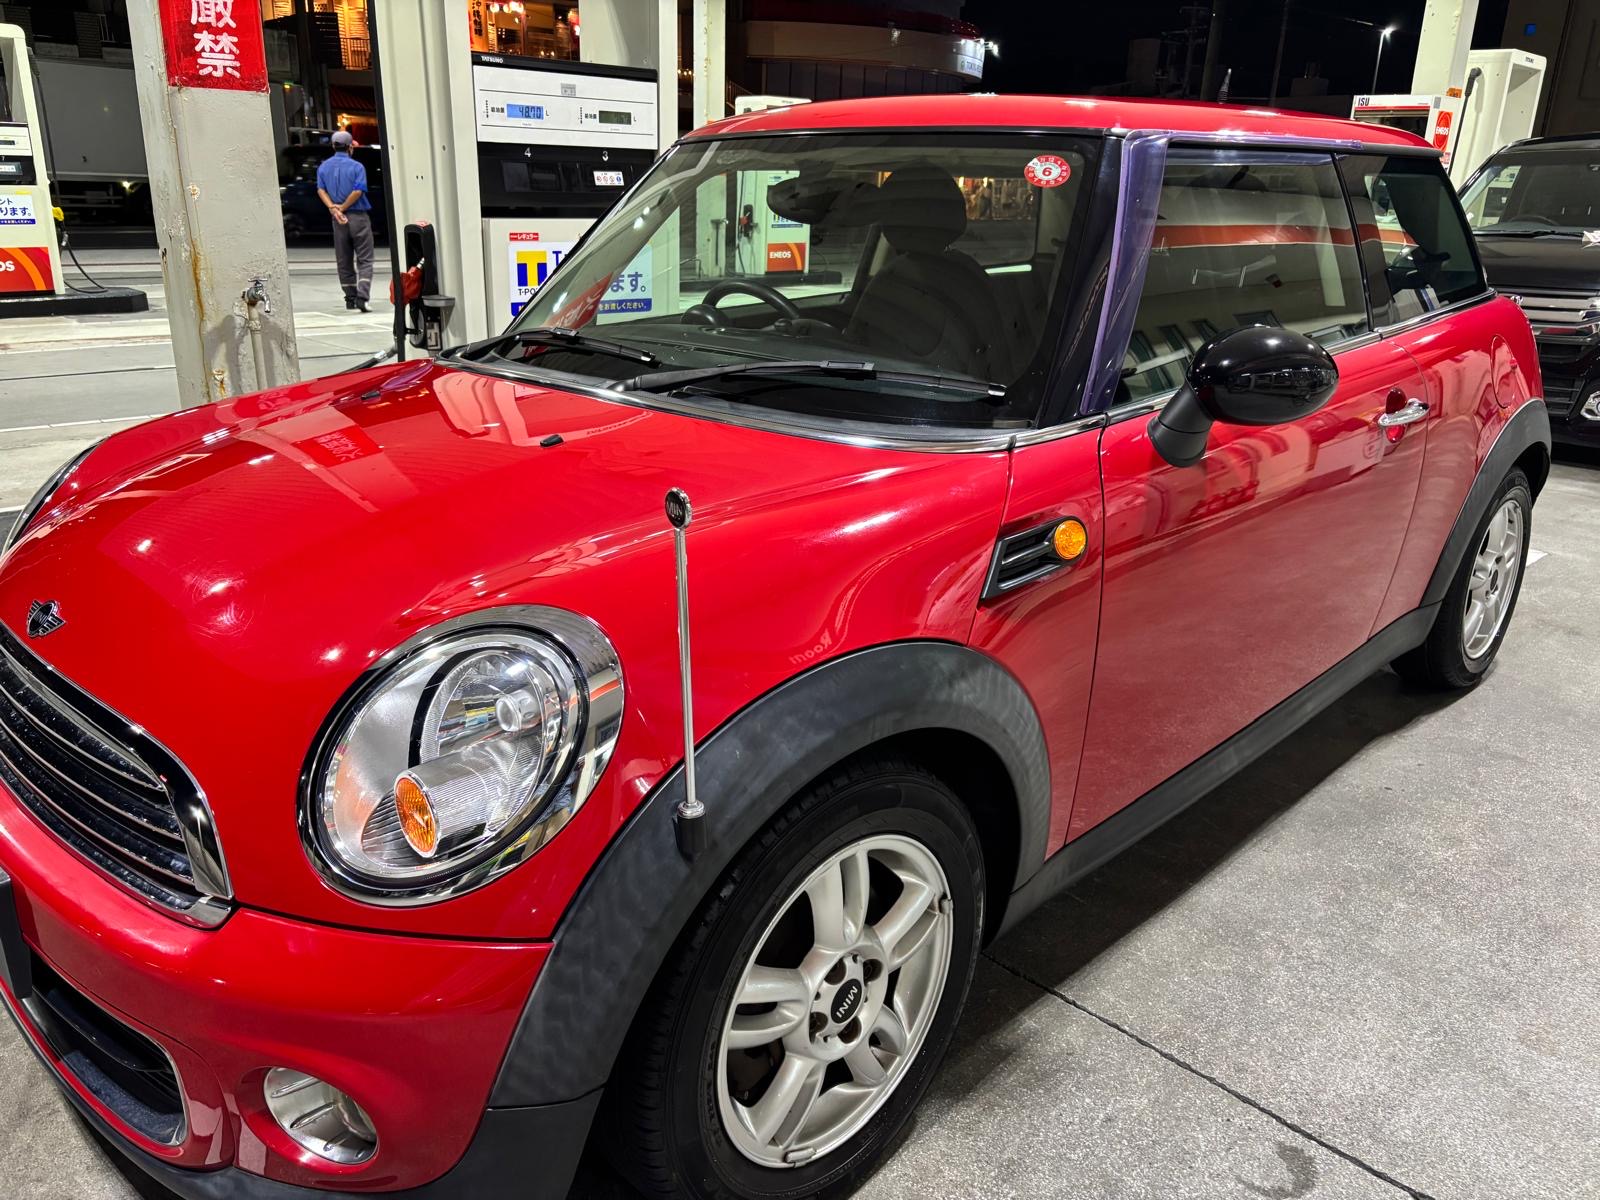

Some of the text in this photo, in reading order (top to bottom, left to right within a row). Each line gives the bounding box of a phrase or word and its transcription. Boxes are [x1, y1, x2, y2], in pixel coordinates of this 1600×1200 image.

[190, 0, 241, 79] 厳禁
[481, 55, 503, 64] TATSUNO
[1435, 126, 1449, 136] ENEOS
[524, 147, 532, 158] 4
[602, 151, 609, 162] 3
[1042, 167, 1052, 176] 6
[769, 251, 792, 259] ENEOS
[518, 287, 539, 296] T-PO
[836, 985, 859, 1018] MINI
